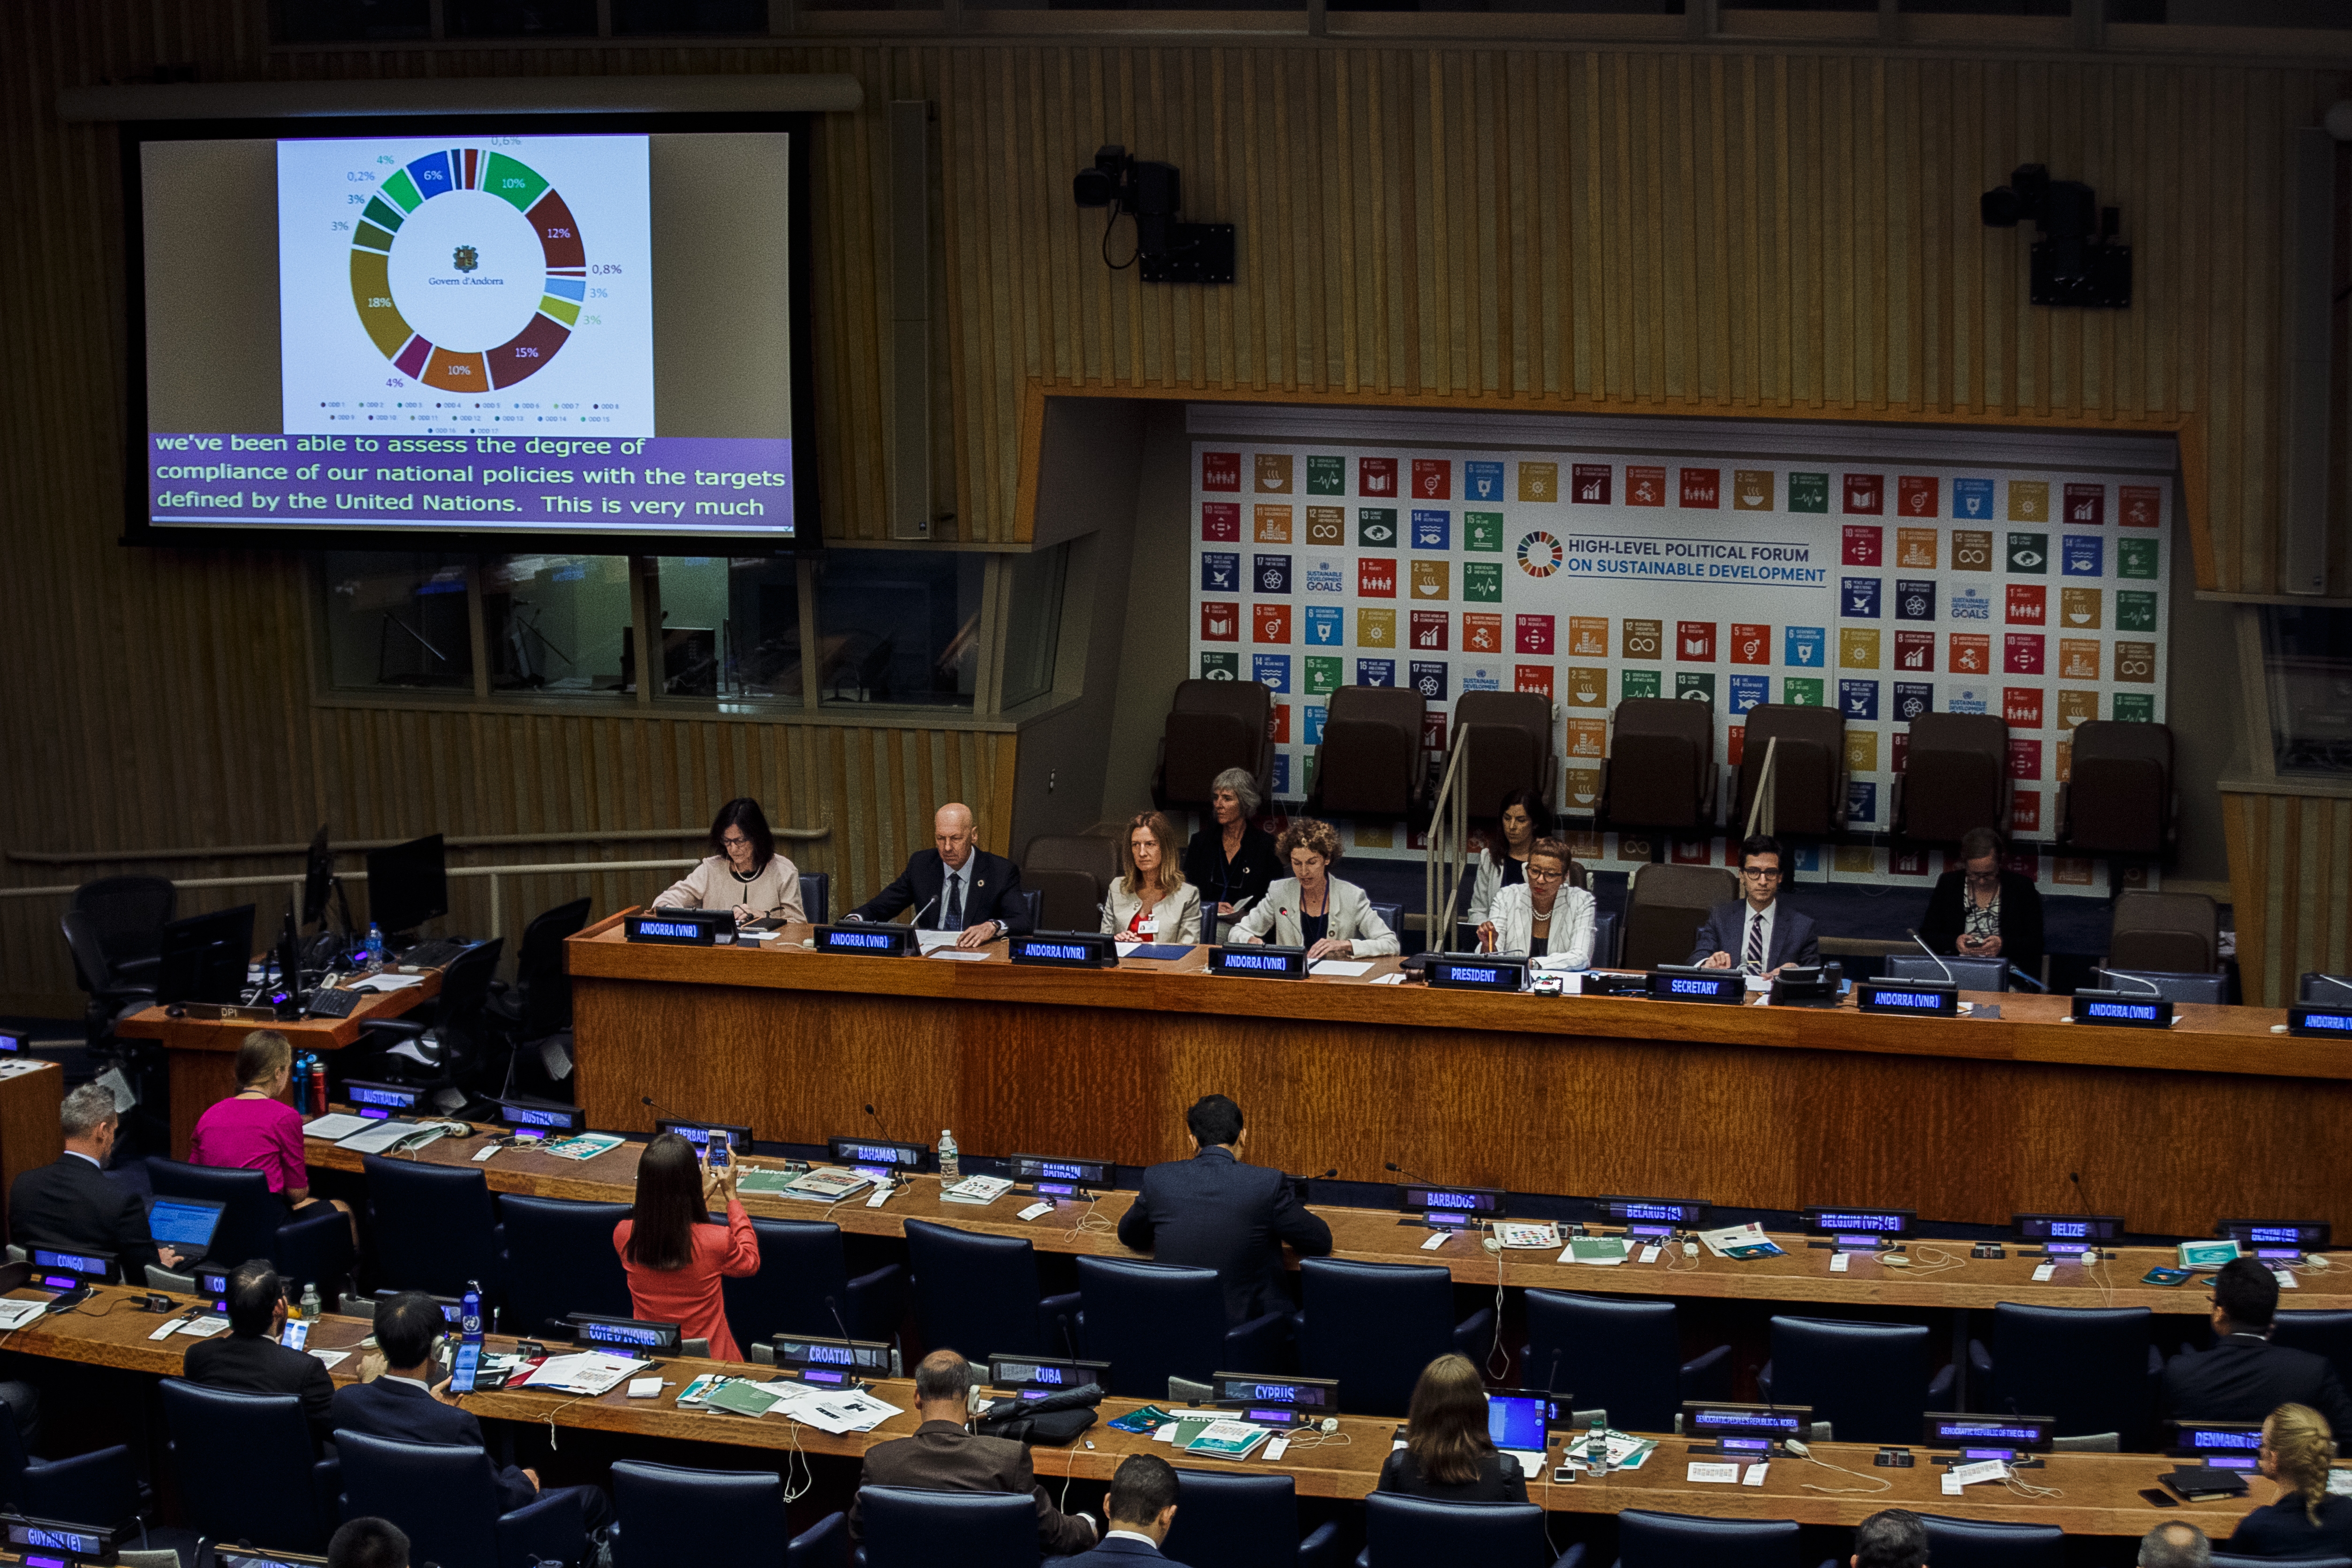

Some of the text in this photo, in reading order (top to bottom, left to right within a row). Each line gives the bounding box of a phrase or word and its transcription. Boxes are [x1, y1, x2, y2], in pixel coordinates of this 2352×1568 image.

[491, 136, 521, 146] 0,6%
[377, 156, 394, 165] 4%
[347, 172, 375, 182] 0,2%
[424, 171, 443, 181] 6%
[502, 178, 525, 189] 10%
[348, 195, 365, 205] 3%
[331, 221, 349, 231] 3%
[547, 229, 570, 239] 12%
[592, 265, 622, 276] 0,8%
[462, 276, 503, 285] d'Andorra
[590, 288, 607, 298] 3%
[368, 298, 391, 308] 18%
[583, 315, 601, 325] 3%
[516, 348, 539, 358] 15%
[448, 366, 470, 375] 10%
[386, 379, 403, 388] 4%
[156, 434, 645, 457] we've been able to assess the degree of
[1310, 459, 1314, 467] 3
[1469, 464, 1473, 473] 6
[1576, 467, 1580, 476] 8
[157, 463, 785, 489] compliance of our national policies with the targets
[158, 491, 763, 517] defined by the United Nations. This is very much
[1205, 506, 1213, 514] 10
[1310, 509, 1316, 518] 12
[1361, 511, 1368, 519] 13
[1467, 515, 1474, 523] 15
[1569, 539, 1808, 562] HIGH-LEVEL POLITICAL FORUM
[1414, 563, 1419, 572] 2
[1568, 558, 1826, 582] ON SUSTAINABLE DEVELOPMENT
[1307, 582, 1342, 591] GOALS
[1845, 580, 1852, 589] 16
[1900, 583, 1906, 591] 17
[1309, 609, 1313, 617] 6
[1413, 614, 1418, 622] 8
[1952, 609, 1988, 619] GOALS
[1466, 615, 1471, 624] 9
[1518, 617, 1526, 626] 10
[1626, 622, 1632, 630] 12
[1680, 624, 1685, 633] 4
[1735, 627, 1739, 635] 5
[1789, 629, 1794, 638] 6
[1898, 634, 1903, 642] 8
[2008, 636, 2015, 645] 10
[1203, 655, 1210, 663] 13
[1255, 657, 1262, 666] 14
[1307, 659, 1314, 668] 15
[1359, 661, 1366, 670] 16
[1413, 664, 1419, 672] 17
[1571, 670, 1576, 679] 2
[1625, 673, 1630, 682] 3
[1678, 675, 1685, 684] 13
[1732, 678, 1740, 686] 14
[1842, 682, 1849, 691] 16
[1897, 685, 1904, 693] 17
[640, 922, 697, 938] ANDORRA (VNR)
[830, 933, 888, 948] ANDORRA (VNR)
[1025, 944, 1085, 960] ANDORRA (VNR)
[1225, 955, 1285, 971] ANDORRA (VNR)
[1451, 968, 1496, 982] PRESIDENT
[1671, 979, 1719, 994] SECRETARY
[1874, 992, 1941, 1008] ANDORRA (VNR)
[2089, 1003, 2156, 1020] ANDORRA (VNR)
[2305, 1015, 2345, 1030] ANDORRA
[522, 1110, 553, 1126] AUSTRIA
[674, 1128, 709, 1144] AZERBAIJ
[858, 1146, 897, 1163] BAHAMAS
[1043, 1162, 1081, 1179] BAHRAIN
[1427, 1192, 1475, 1208] BARBADOS
[1627, 1204, 1682, 1221] BELARUS (E)
[1821, 1214, 1861, 1228] BELGIUM
[2051, 1223, 2086, 1237] BELIZE
[57, 1254, 84, 1271] CONGO
[809, 1346, 851, 1365] CROATIA
[1035, 1367, 1062, 1384] CUBA
[1255, 1385, 1295, 1402] CYPRUS
[1696, 1415, 1727, 1424] DEMOCRATIC
[1750, 1417, 1773, 1426] REPUBLIC
[1604, 1429, 1647, 1443] Latvia
[1941, 1427, 1973, 1436] DEMOCRATIC
[2195, 1432, 2246, 1447] DENMARK
[28, 1529, 81, 1552] GUYANA (E)
